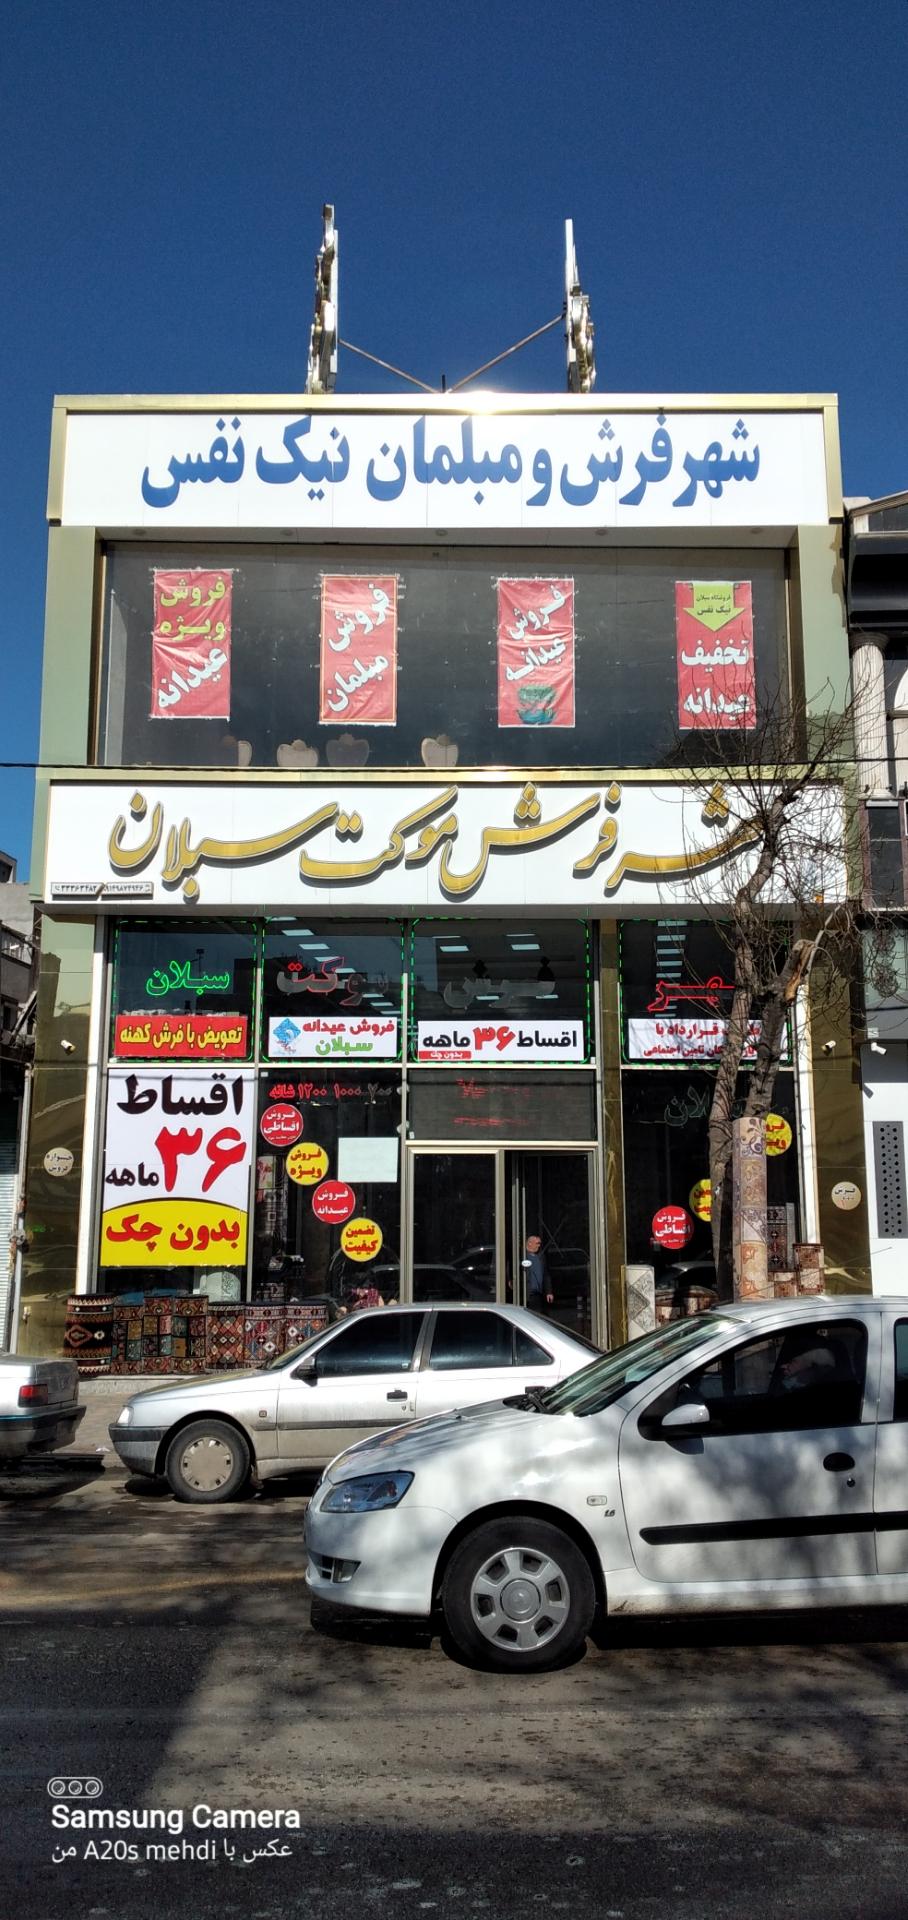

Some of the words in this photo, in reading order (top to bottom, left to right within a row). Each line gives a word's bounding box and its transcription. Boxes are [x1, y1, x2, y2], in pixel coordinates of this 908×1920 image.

[141, 416, 245, 508] نفس
[256, 414, 350, 501] نیک
[366, 414, 522, 506] مبلمان
[560, 414, 673, 506] فرش
[672, 418, 760, 507] شهر
[526, 448, 553, 506] و
[160, 576, 226, 607] فروش
[328, 583, 390, 652] فروش
[508, 584, 566, 640] فروش
[160, 616, 226, 641] ویژه
[506, 636, 567, 682] عیدانه
[681, 639, 750, 673] تخفیف
[158, 647, 228, 709] عیدانه
[327, 655, 390, 712] مبلمان
[683, 687, 752, 720] عیدانه
[107, 789, 339, 898] سبلان
[299, 784, 459, 880] موکت
[439, 781, 619, 895] فرش
[146, 960, 230, 996] سبلان
[119, 1023, 152, 1044] کهنه
[153, 1022, 184, 1049] فرش
[186, 1023, 195, 1048] با
[197, 1025, 243, 1049] تعویض
[302, 1018, 346, 1035] عیدانه
[350, 1018, 395, 1036] فروش
[422, 1031, 471, 1047] ماهه
[472, 1026, 516, 1051] ۳۶
[516, 1030, 577, 1047] اقساط
[655, 1023, 664, 1037] با
[667, 1022, 719, 1040] قرارداد
[315, 1035, 373, 1056] سبلان
[117, 1073, 244, 1116] اقساط
[263, 1121, 300, 1134] اقساطی
[266, 1110, 296, 1120] فروش
[155, 1126, 247, 1193] ۳۶
[290, 1147, 322, 1161] فروش
[105, 1162, 160, 1187] ماهه
[290, 1164, 322, 1179] ویژه
[317, 1189, 349, 1201] فروش
[317, 1203, 349, 1215] عیدانه
[657, 1212, 685, 1222] فروش
[106, 1213, 163, 1252] چک
[169, 1219, 241, 1251] بدون
[345, 1224, 376, 1238] تضمین
[344, 1240, 378, 1255] کیفیت
